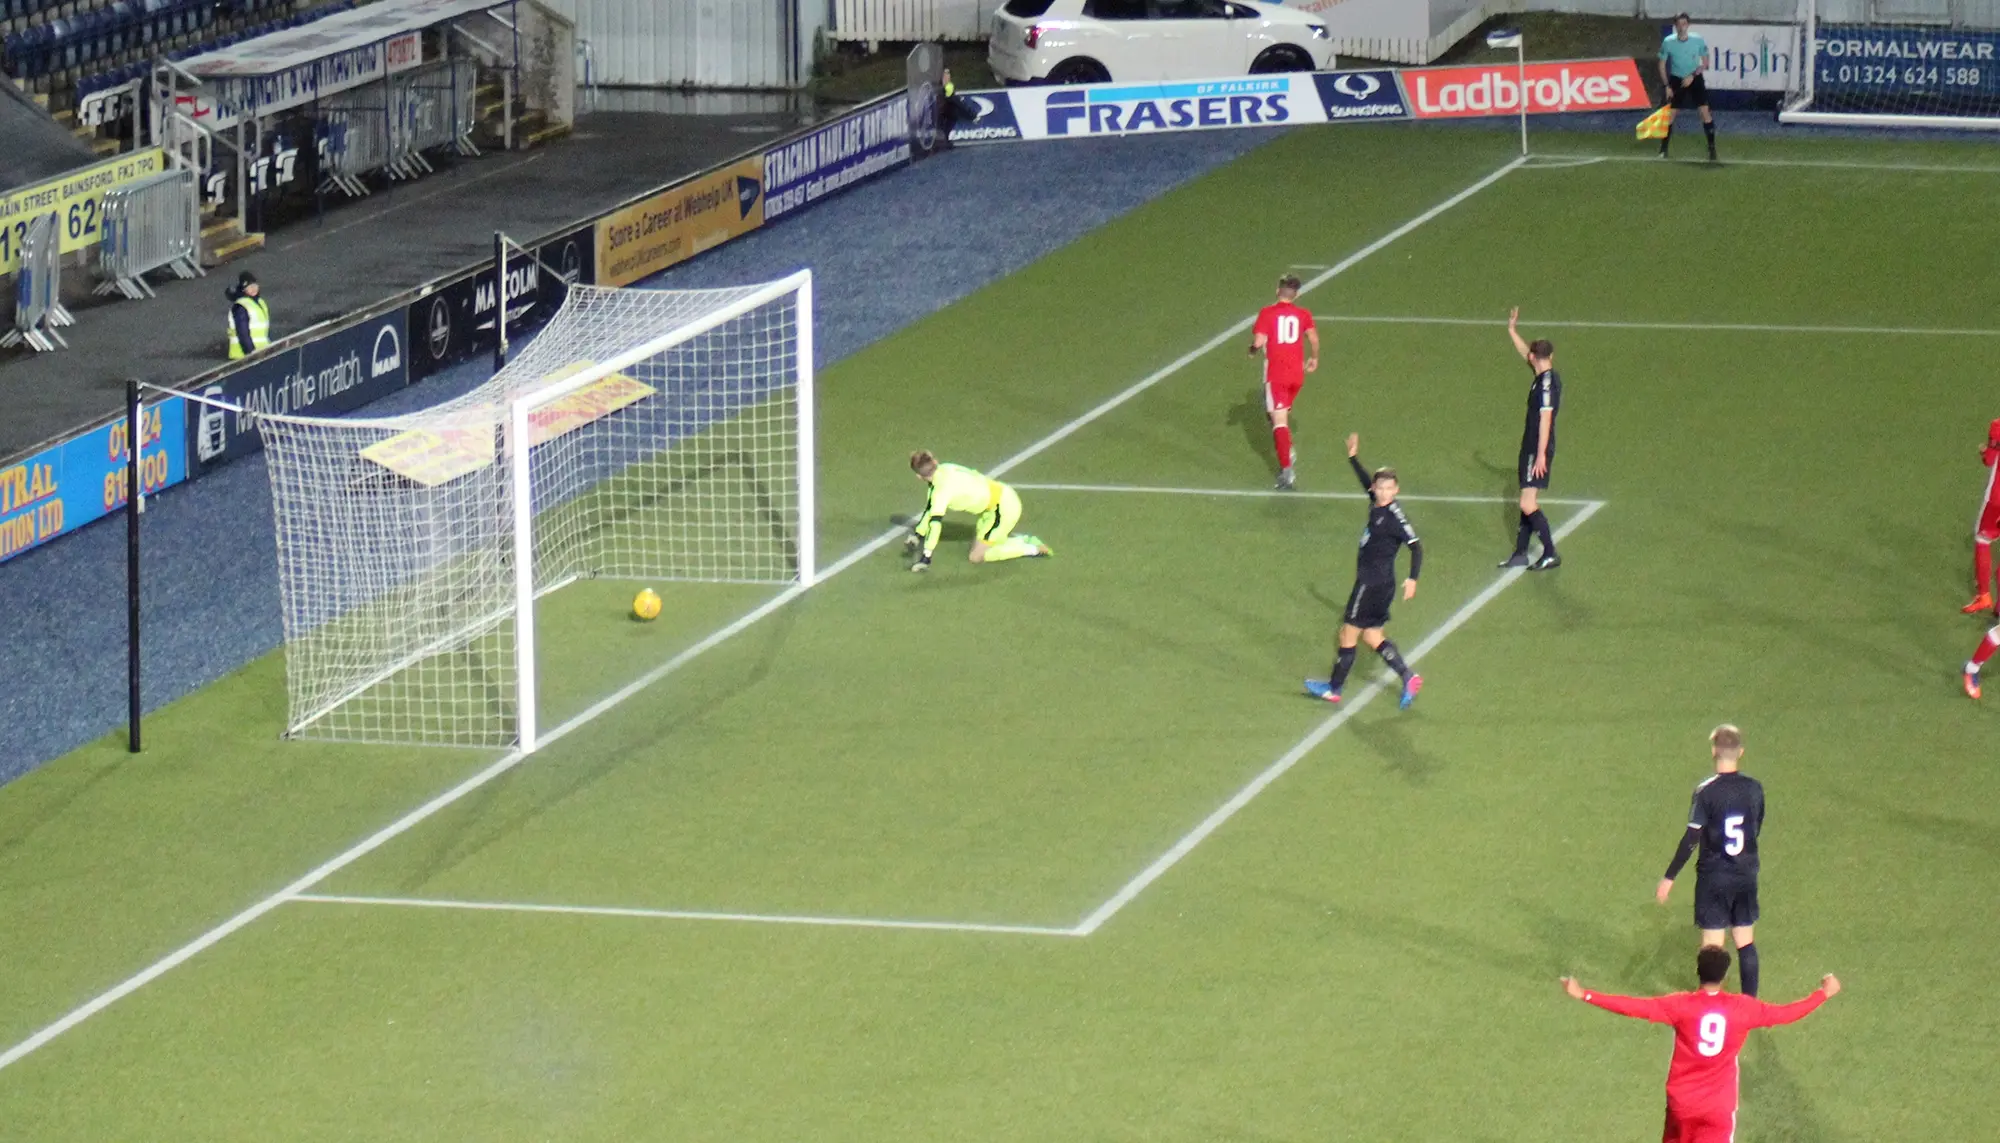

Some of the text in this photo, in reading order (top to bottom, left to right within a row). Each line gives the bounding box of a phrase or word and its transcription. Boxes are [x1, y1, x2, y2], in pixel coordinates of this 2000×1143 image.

[1815, 40, 1994, 60] FORMALWEAR
[1417, 69, 1631, 112] Ladbrokes
[1839, 66, 1896, 84] 01324
[1904, 67, 1937, 84] 624
[1945, 67, 1980, 85] 588
[948, 126, 1017, 140] SANGYONG
[1046, 91, 1290, 135] FRASERS
[118, 163, 135, 181] FK2
[609, 224, 633, 251] Score
[642, 202, 673, 236] Career
[475, 263, 537, 315] MACOLM
[1277, 315, 1300, 344] 10
[275, 375, 289, 415] of
[292, 372, 316, 411] the
[318, 350, 364, 400] match.
[109, 406, 162, 462] 0124
[0, 497, 64, 555] TION LTD
[1724, 816, 1745, 857] 5
[1699, 1013, 1727, 1058] 9
